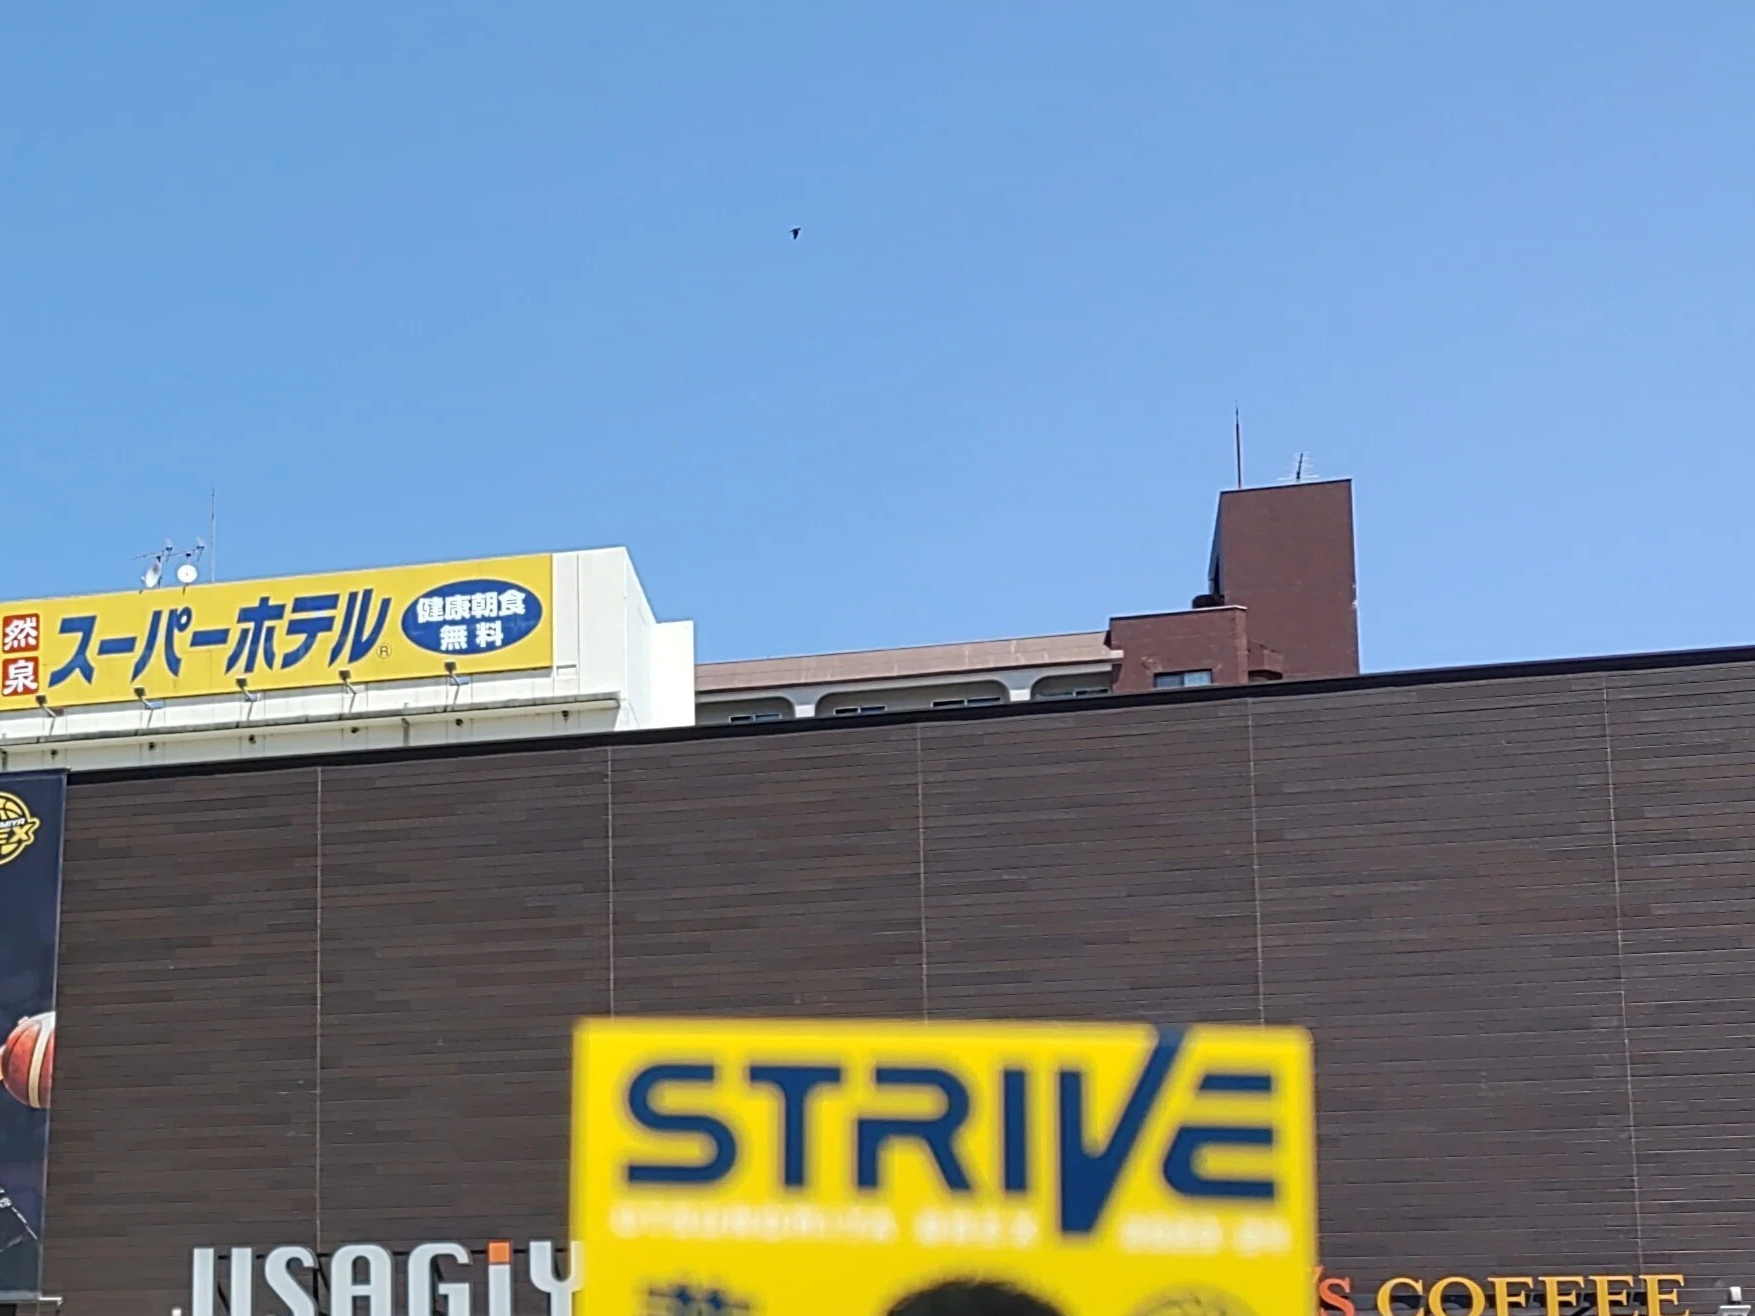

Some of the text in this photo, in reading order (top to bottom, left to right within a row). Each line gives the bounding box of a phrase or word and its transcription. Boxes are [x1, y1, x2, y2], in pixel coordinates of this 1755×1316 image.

[48, 588, 392, 688] スーパーホテル
[417, 589, 526, 623] 健康朝食
[440, 620, 504, 650] 無料
[626, 1027, 1276, 1237] STRIVE
